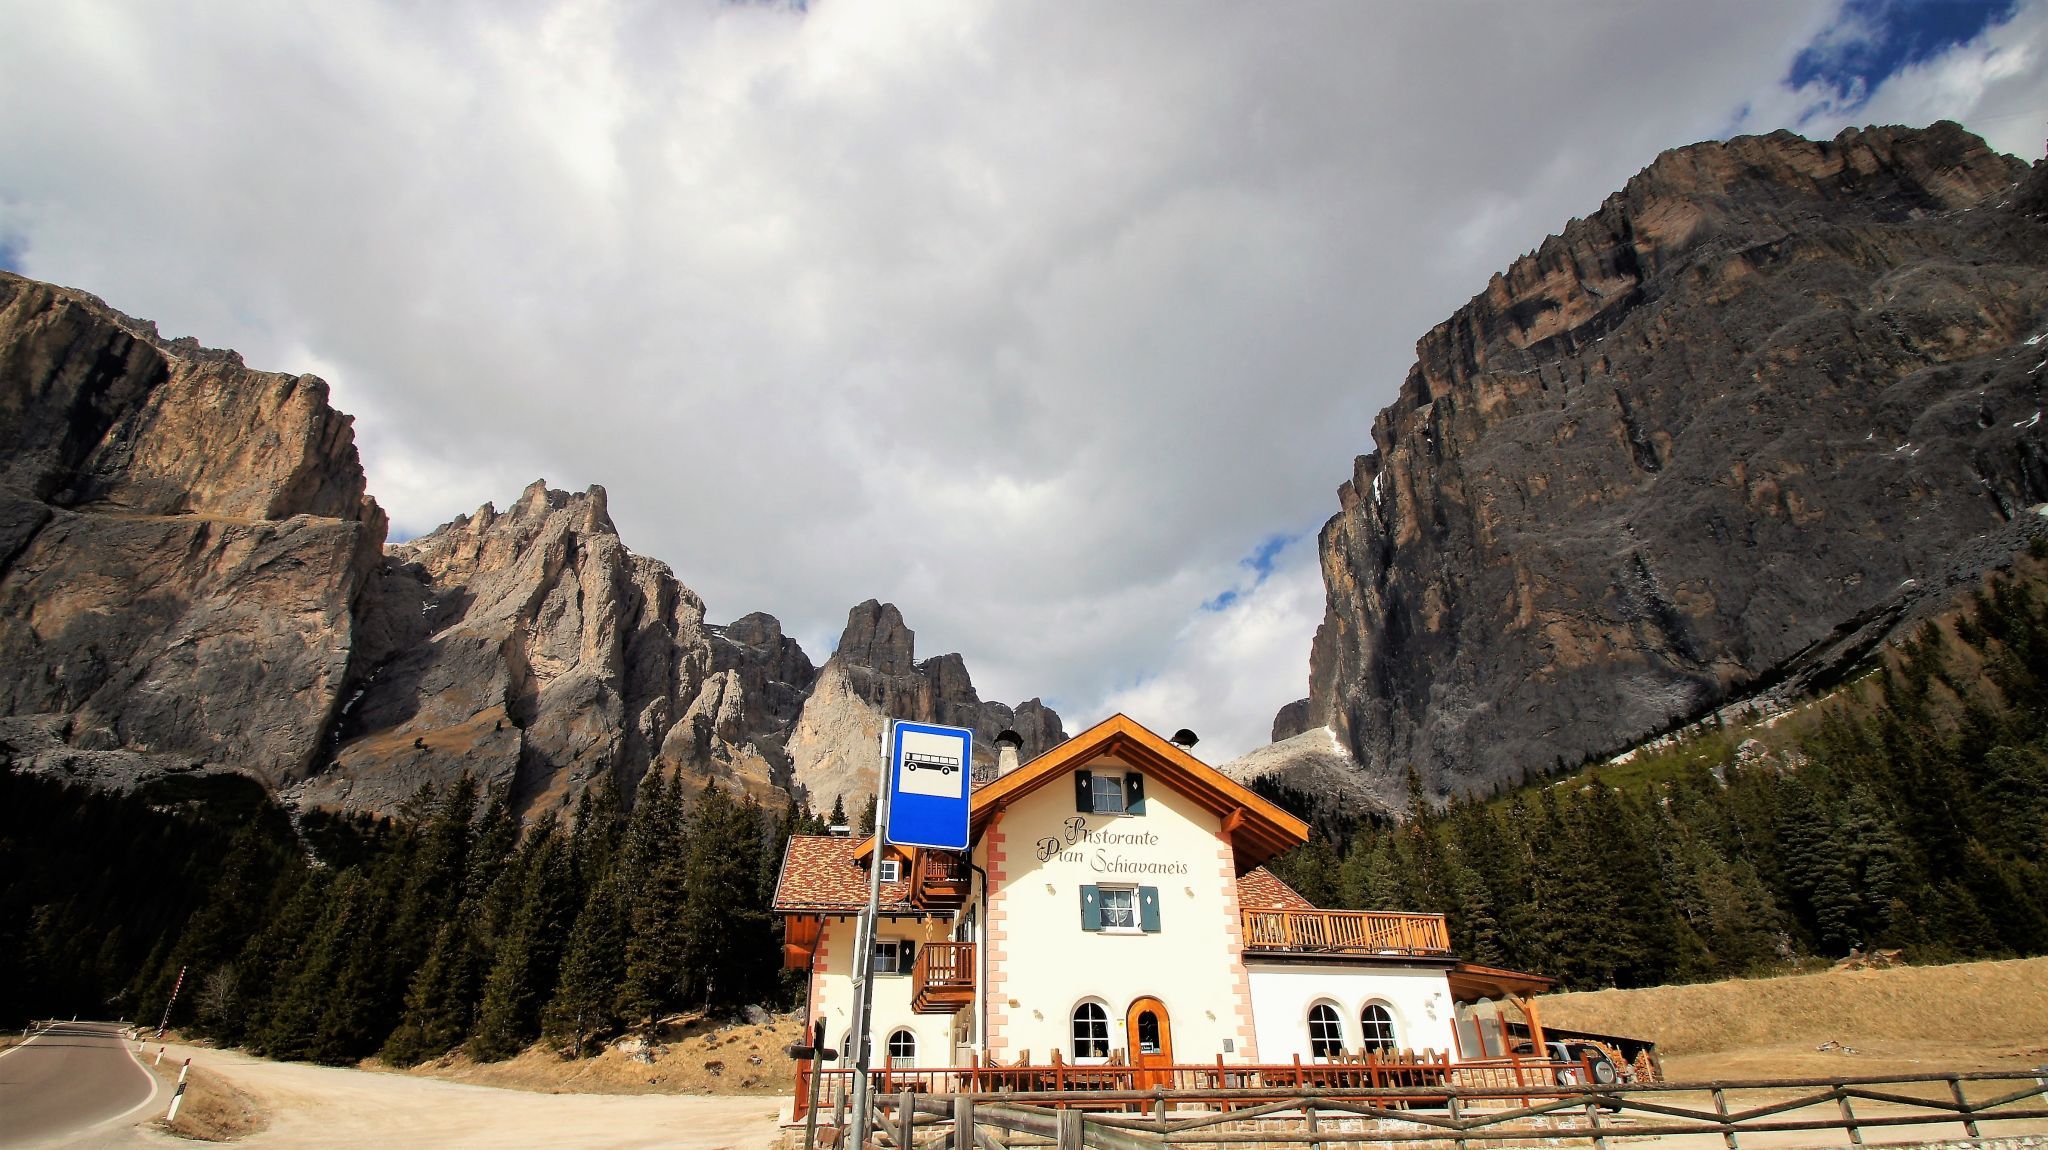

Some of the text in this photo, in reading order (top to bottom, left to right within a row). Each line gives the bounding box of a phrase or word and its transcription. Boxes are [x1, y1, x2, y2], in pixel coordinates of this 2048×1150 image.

[1064, 816, 1159, 846] Ristorante
[1036, 836, 1188, 875] Pian Schiavaneis
